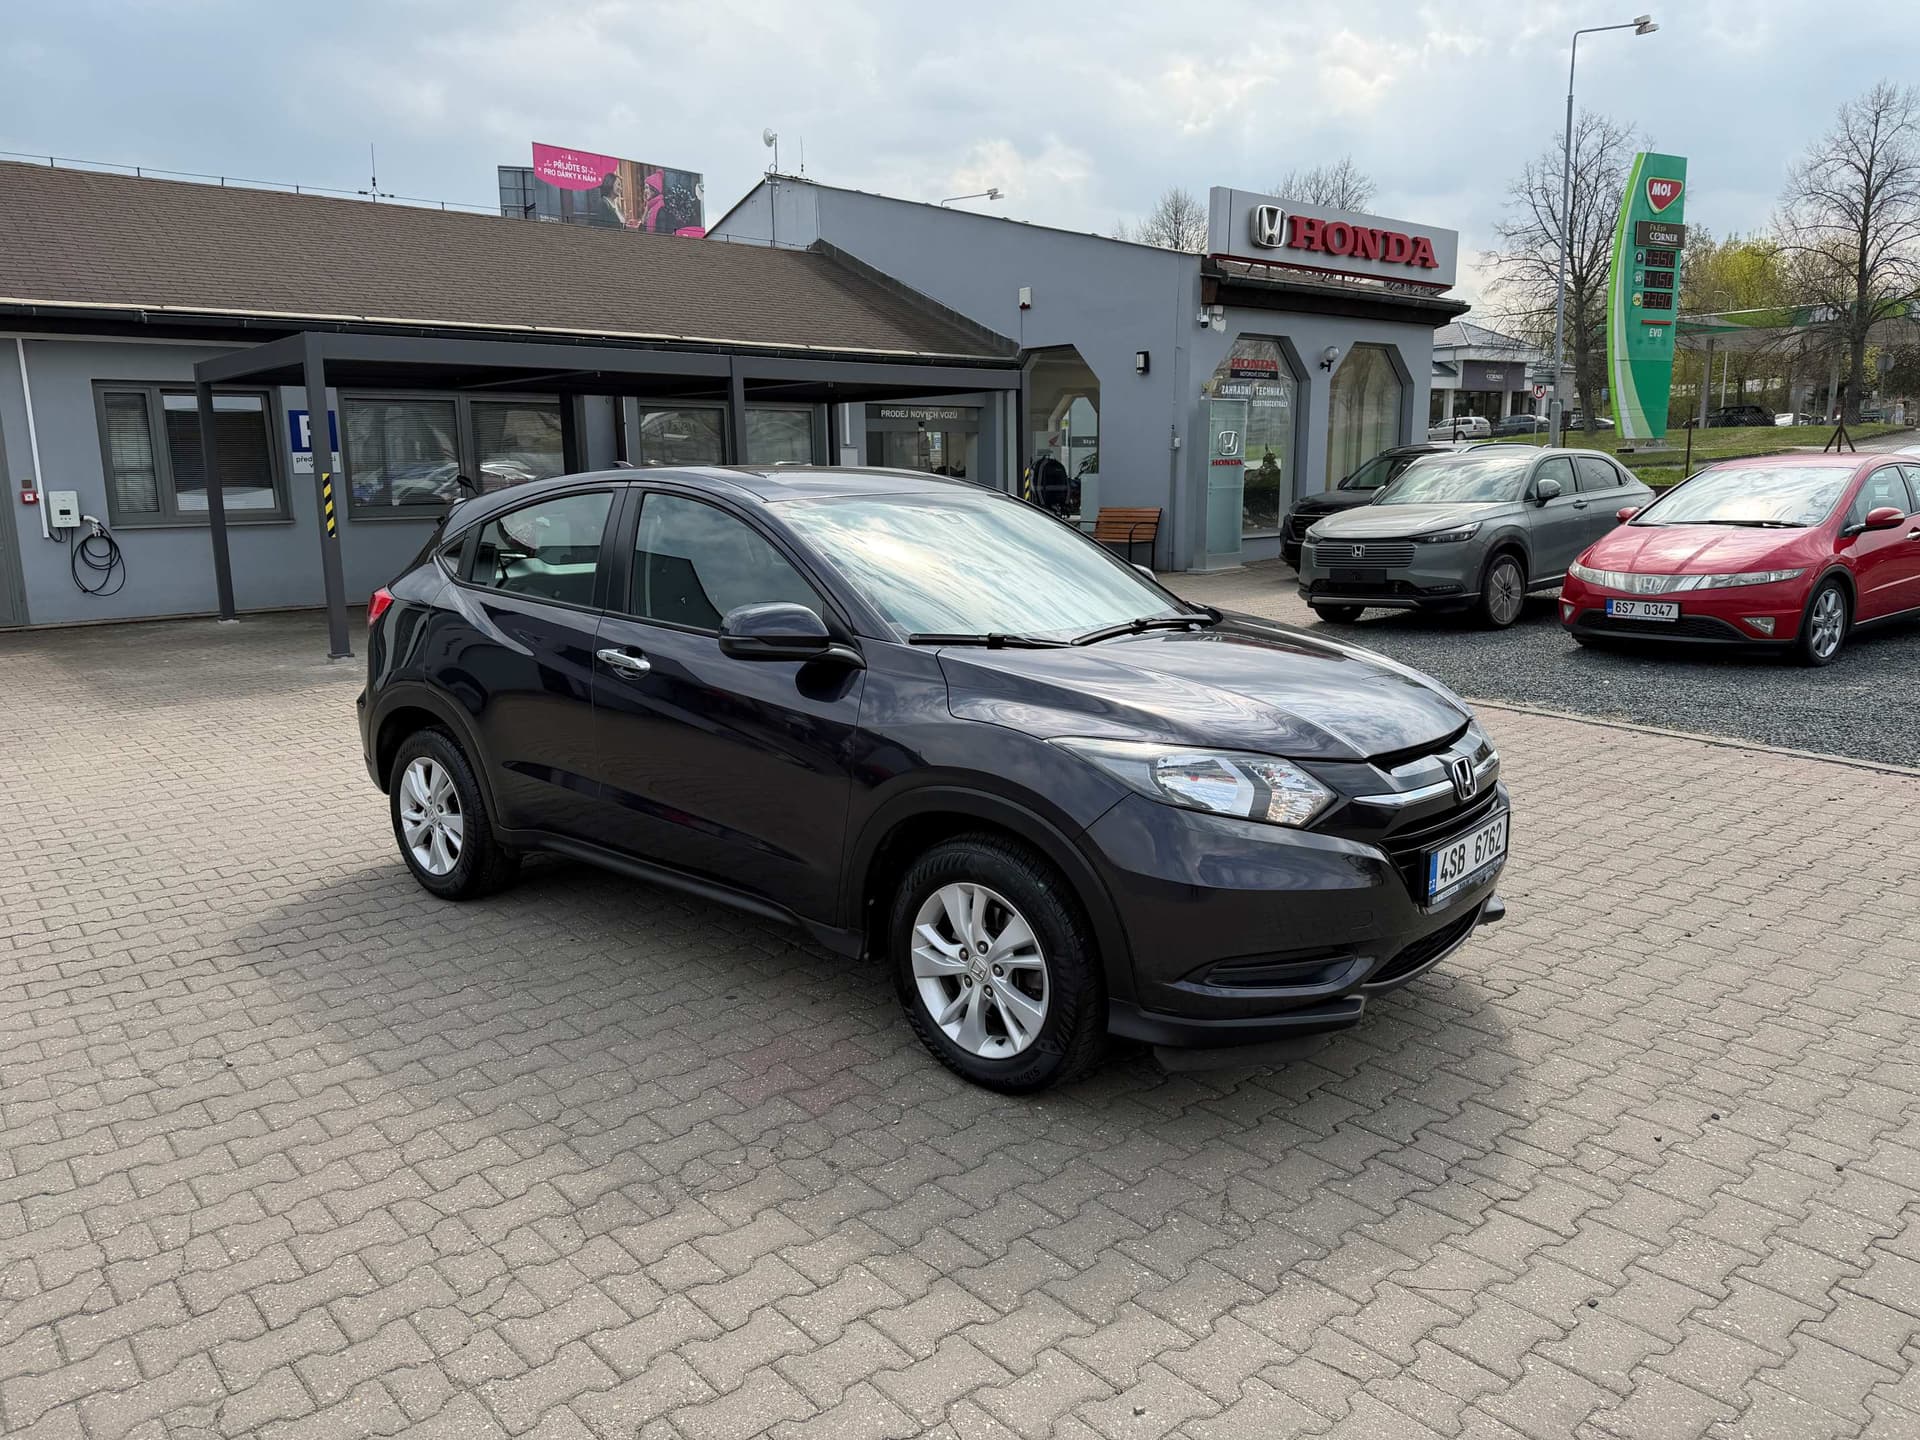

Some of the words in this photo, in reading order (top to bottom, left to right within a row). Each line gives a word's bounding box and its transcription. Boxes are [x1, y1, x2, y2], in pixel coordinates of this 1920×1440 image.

[543, 168, 556, 176] PRO
[1651, 182, 1672, 197] MOL
[1289, 215, 1439, 269] HONDA
[1649, 231, 1679, 242] CORNER
[1231, 358, 1279, 370] HONDA
[1256, 386, 1284, 396] TECHNIKA
[881, 409, 909, 418] PRODEJ
[1615, 602, 1635, 614] 6S7
[1644, 604, 1673, 617] 0347
[1440, 843, 1466, 883] 4SB
[1474, 822, 1503, 865] 6762
